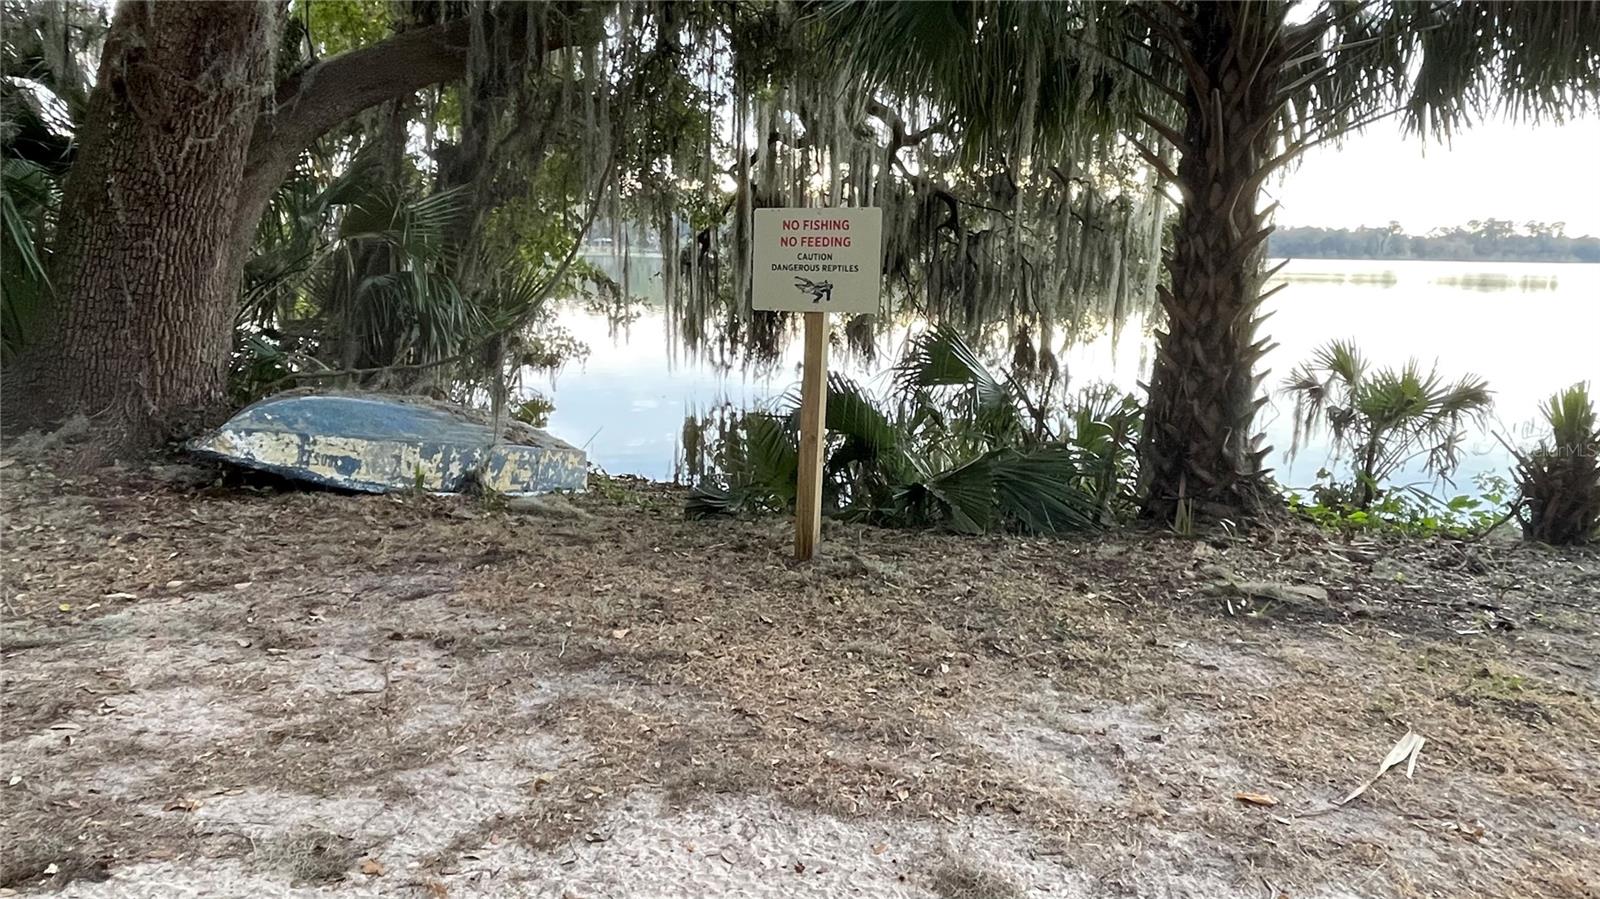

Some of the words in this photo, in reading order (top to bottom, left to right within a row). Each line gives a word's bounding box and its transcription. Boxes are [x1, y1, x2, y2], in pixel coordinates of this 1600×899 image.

[782, 219, 800, 231] NO
[803, 219, 850, 231] FISHING
[780, 236, 798, 247] NO
[800, 236, 851, 248] FEEDING
[797, 253, 833, 261] CAUTION
[771, 263, 820, 272] DANGEROUS
[822, 264, 859, 273] REPTILES
